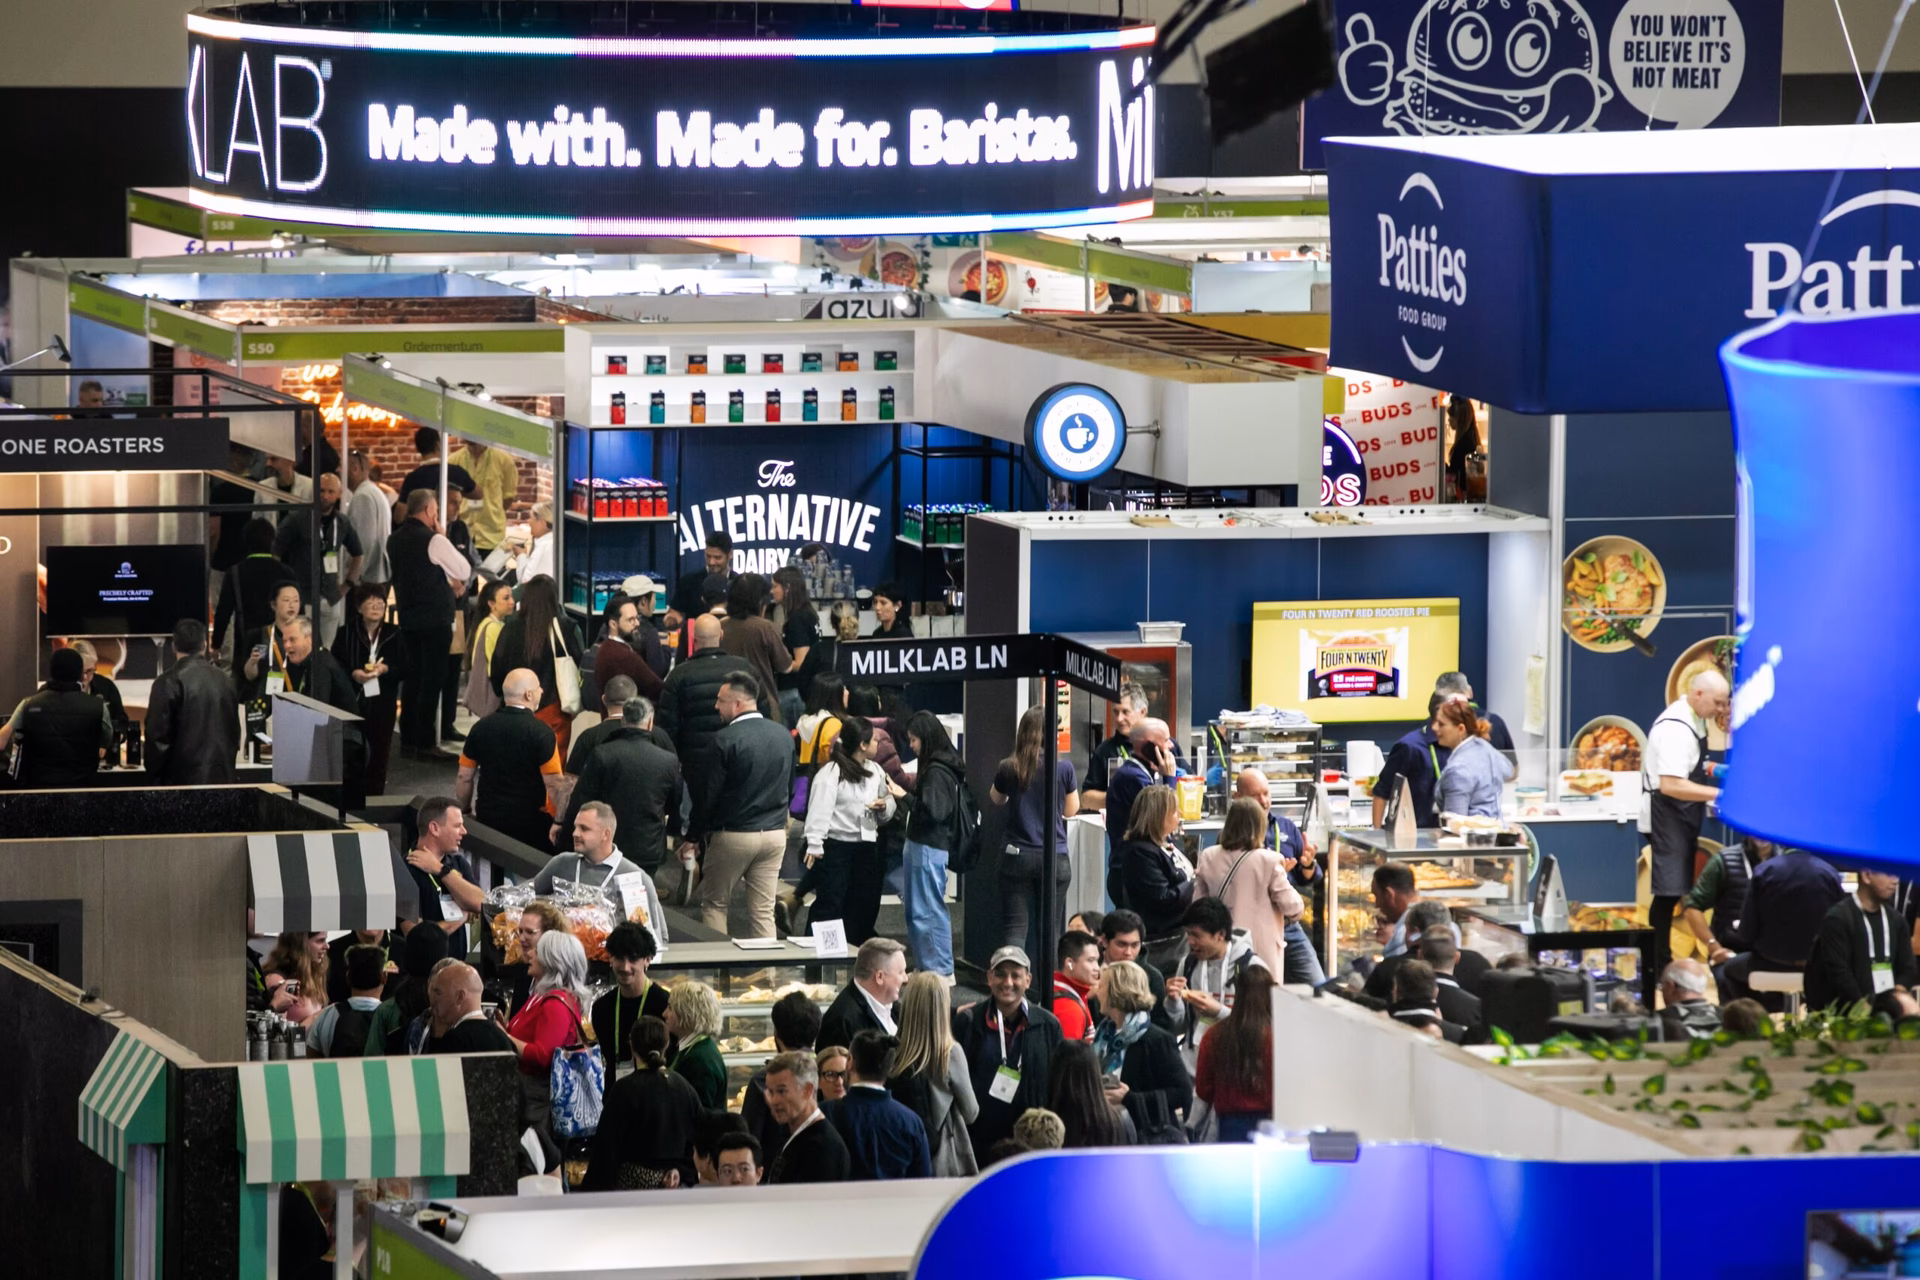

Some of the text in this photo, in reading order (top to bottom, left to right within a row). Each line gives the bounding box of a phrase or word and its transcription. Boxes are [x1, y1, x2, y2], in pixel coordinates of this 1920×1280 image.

[1630, 15, 1727, 37] YOU WON'T
[1624, 41, 1731, 63] BELIEVE IT'S
[1633, 67, 1721, 89] NOT MEAT
[368, 102, 1078, 168] Made with. Made for. Baristas.
[1378, 213, 1467, 306] Patties
[1744, 242, 1920, 319] Patt
[1398, 305, 1447, 332] FOOD GROUP
[248, 343, 275, 354] S50
[403, 340, 484, 352] Ordermentum
[1361, 402, 1412, 424] BUDS
[1, 437, 164, 455] ONE ROASTERS
[757, 459, 797, 488] The
[1370, 460, 1421, 482] BUDS
[1410, 486, 1434, 503] BU
[671, 493, 881, 556] ALTERNATIVE
[732, 548, 790, 575] DAIRY
[1282, 606, 1430, 619] FOUR N TWENTY RED ROOSTER PIE
[851, 644, 1008, 675] MILKLAB LN
[1354, 649, 1388, 668] TWENTY
[1066, 650, 1118, 692] MILKLAB LN
